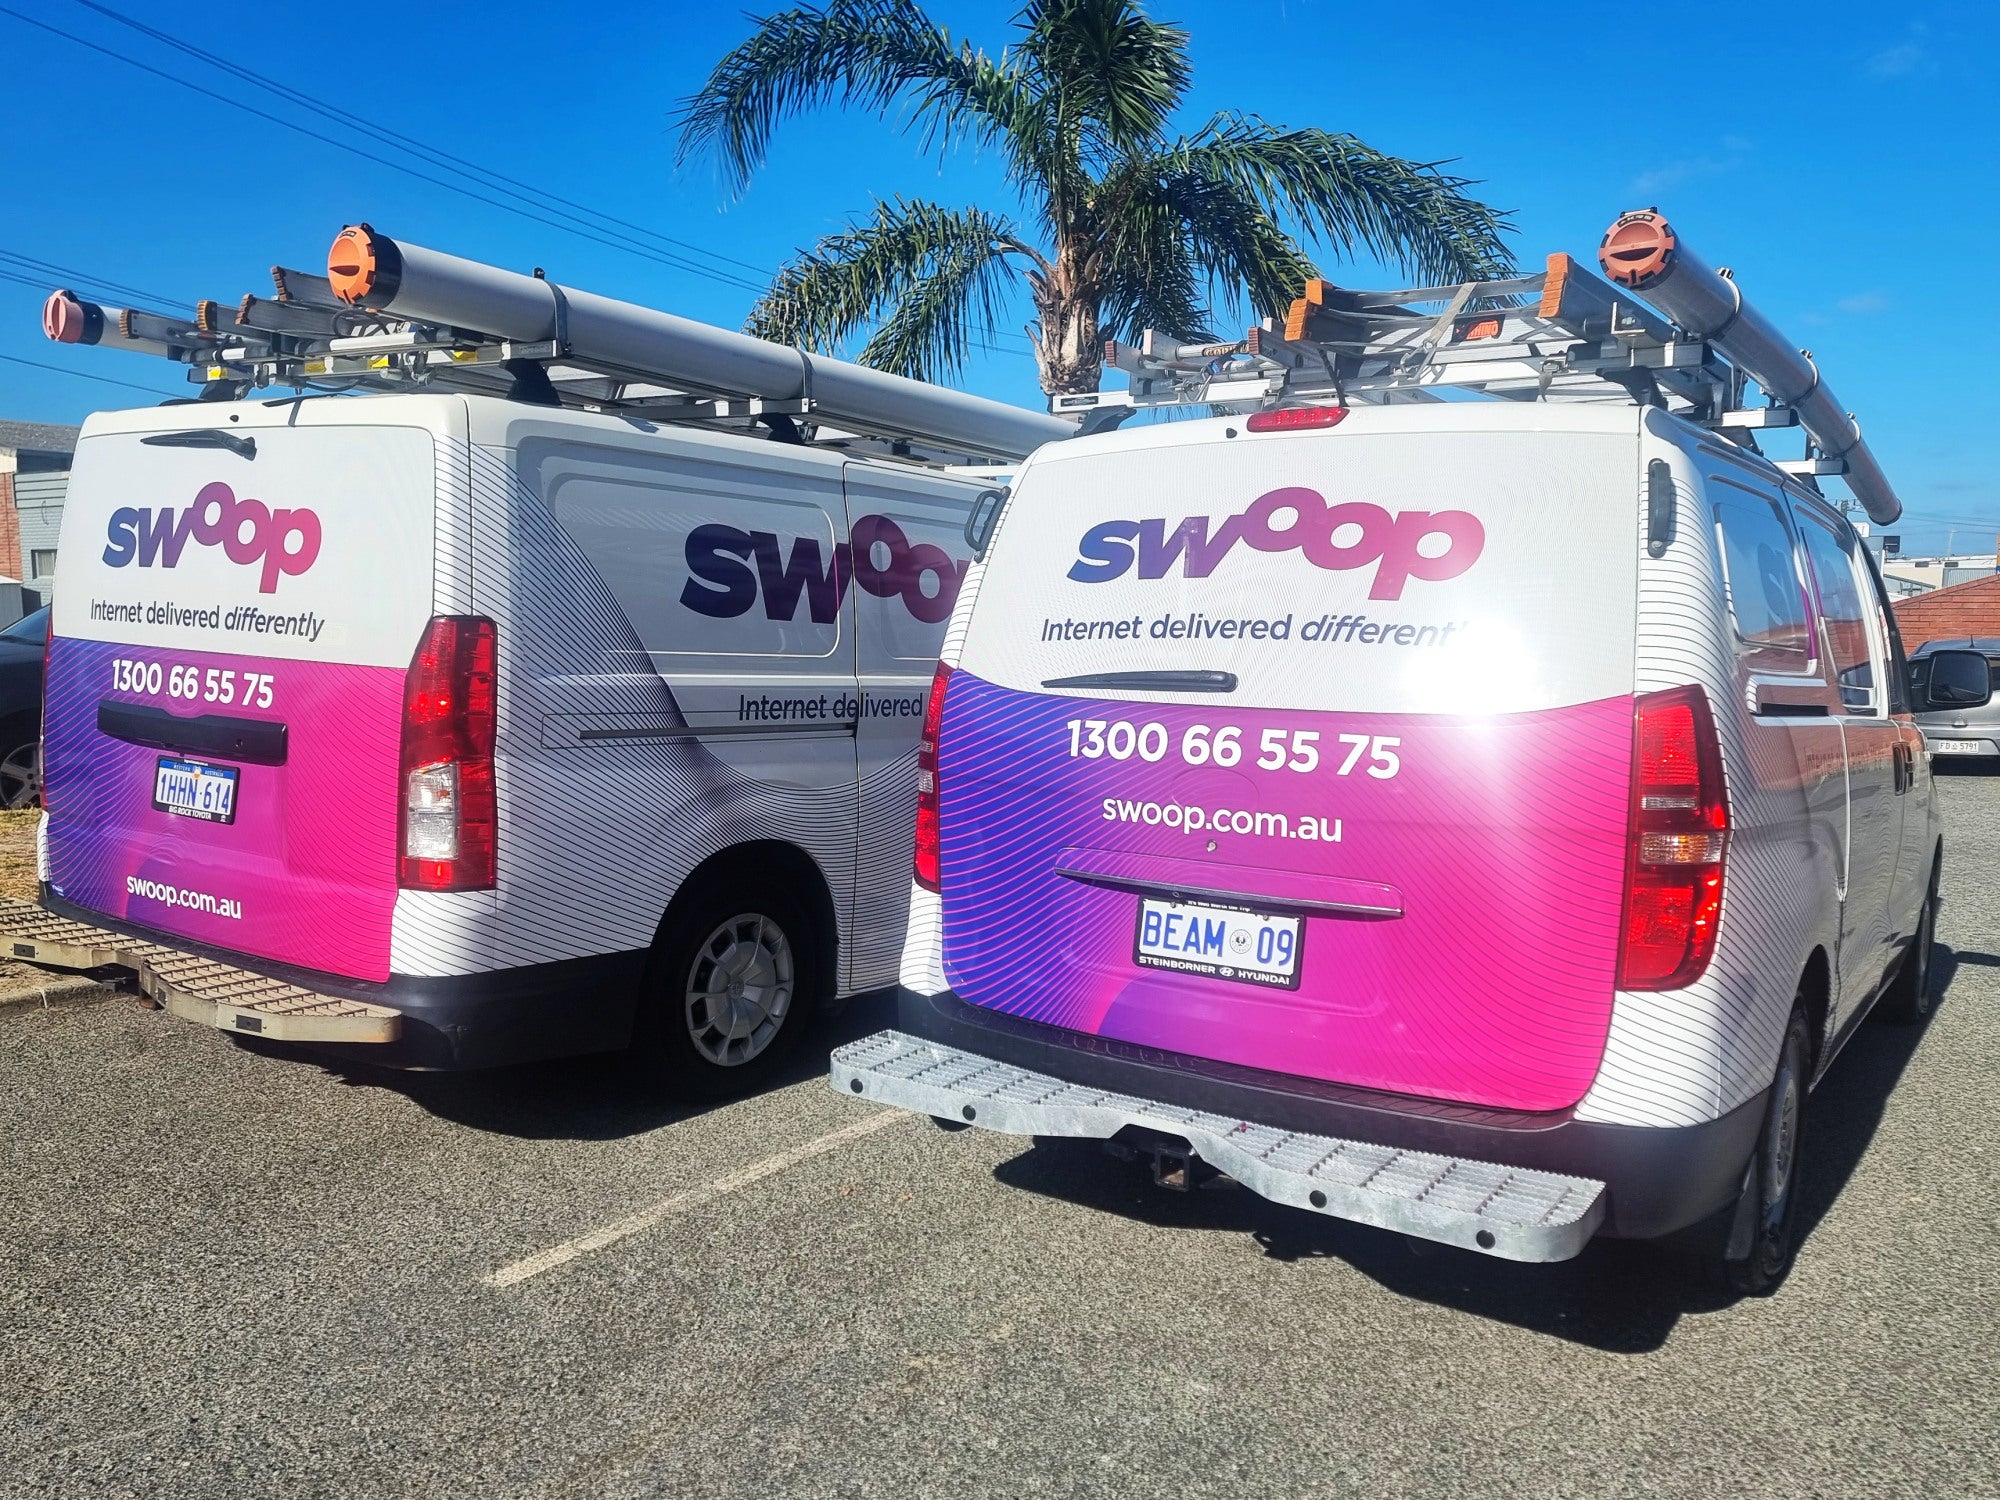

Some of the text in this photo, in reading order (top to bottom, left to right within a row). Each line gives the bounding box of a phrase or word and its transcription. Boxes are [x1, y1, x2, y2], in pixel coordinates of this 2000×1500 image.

[102, 482, 322, 593] swoop
[1066, 486, 1485, 600] swoop
[679, 513, 971, 624] swoo
[91, 598, 325, 642] Internet delivered differently
[1041, 616, 1143, 643] Internet
[1150, 614, 1292, 642] delivered
[112, 660, 274, 708] 1300 66 55 75
[739, 692, 924, 721] Internet delivered
[1067, 718, 1402, 780] 1300 66 55 75
[178, 808, 192, 817] ROCK
[192, 810, 212, 820] TOYOTA
[1102, 796, 1342, 843] swoop.com.au
[127, 874, 242, 920] swoop.com.au
[1143, 910, 1226, 957] BEAM
[1256, 926, 1294, 967] 09
[1139, 955, 1290, 985] STEINBORNER HYUNDAI
